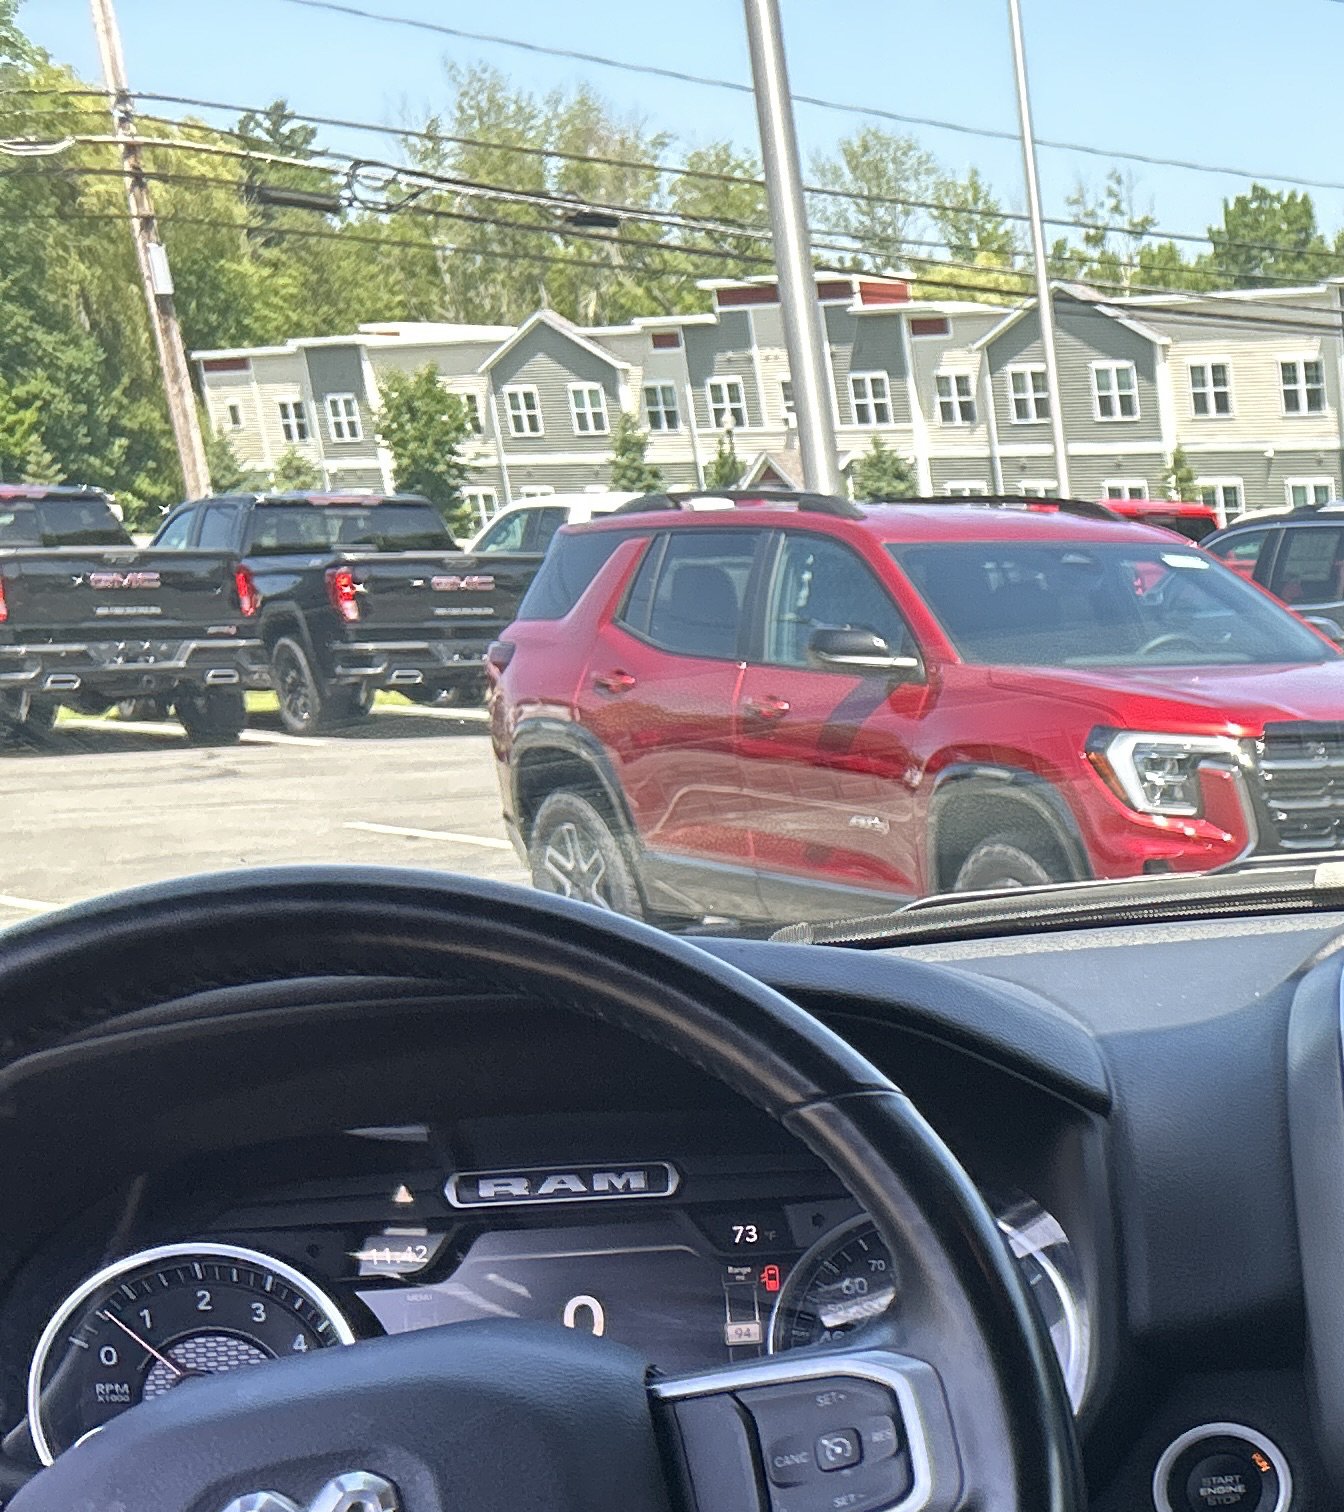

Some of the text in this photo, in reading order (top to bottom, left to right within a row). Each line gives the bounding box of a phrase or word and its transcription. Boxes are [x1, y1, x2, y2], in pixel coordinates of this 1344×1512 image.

[479, 1171, 648, 1198] RAM
[732, 1225, 758, 1244] 73
[868, 1260, 886, 1272] 70
[842, 1277, 869, 1295] 60
[197, 1290, 213, 1311] 2
[139, 1308, 152, 1328] 1
[251, 1302, 267, 1322] 3
[293, 1333, 309, 1352] 4
[734, 1328, 752, 1339] 94
[99, 1346, 119, 1366] 0
[96, 1383, 130, 1395] RPM
[774, 1452, 809, 1468] CANC
[1202, 1475, 1241, 1487] START
[1200, 1485, 1246, 1496] ENGINE
[1207, 1496, 1241, 1506] STOP
